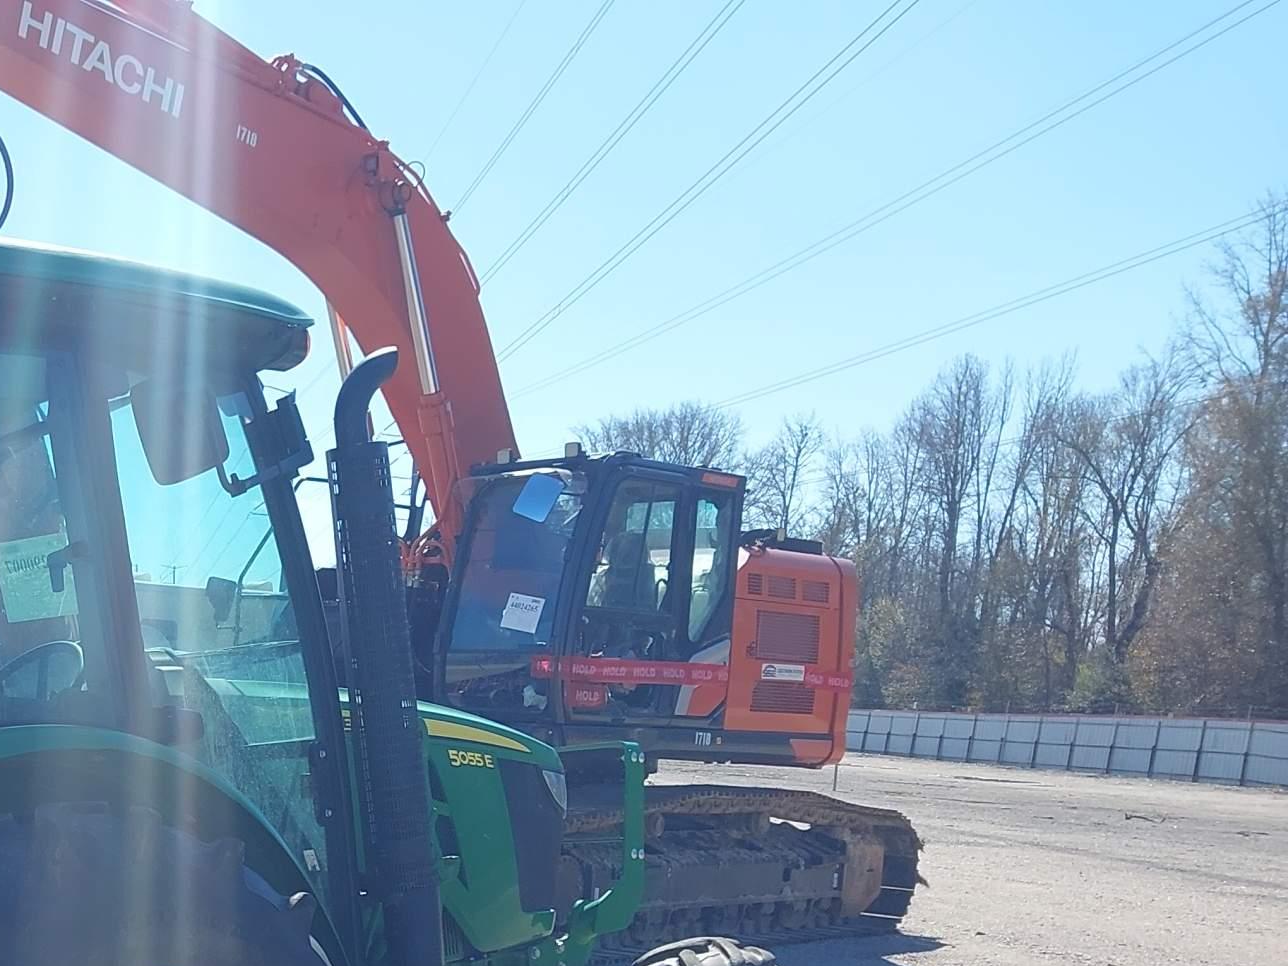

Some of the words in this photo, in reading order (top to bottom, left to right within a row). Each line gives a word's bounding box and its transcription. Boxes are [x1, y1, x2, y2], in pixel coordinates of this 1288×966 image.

[18, 1, 185, 118] HITACHI
[572, 664, 596, 675] HOLD
[602, 666, 626, 677] HOLD
[633, 667, 656, 677] HOLD
[663, 668, 685, 678] HOLD
[692, 670, 713, 680] HOLD
[575, 689, 600, 702] HOLD
